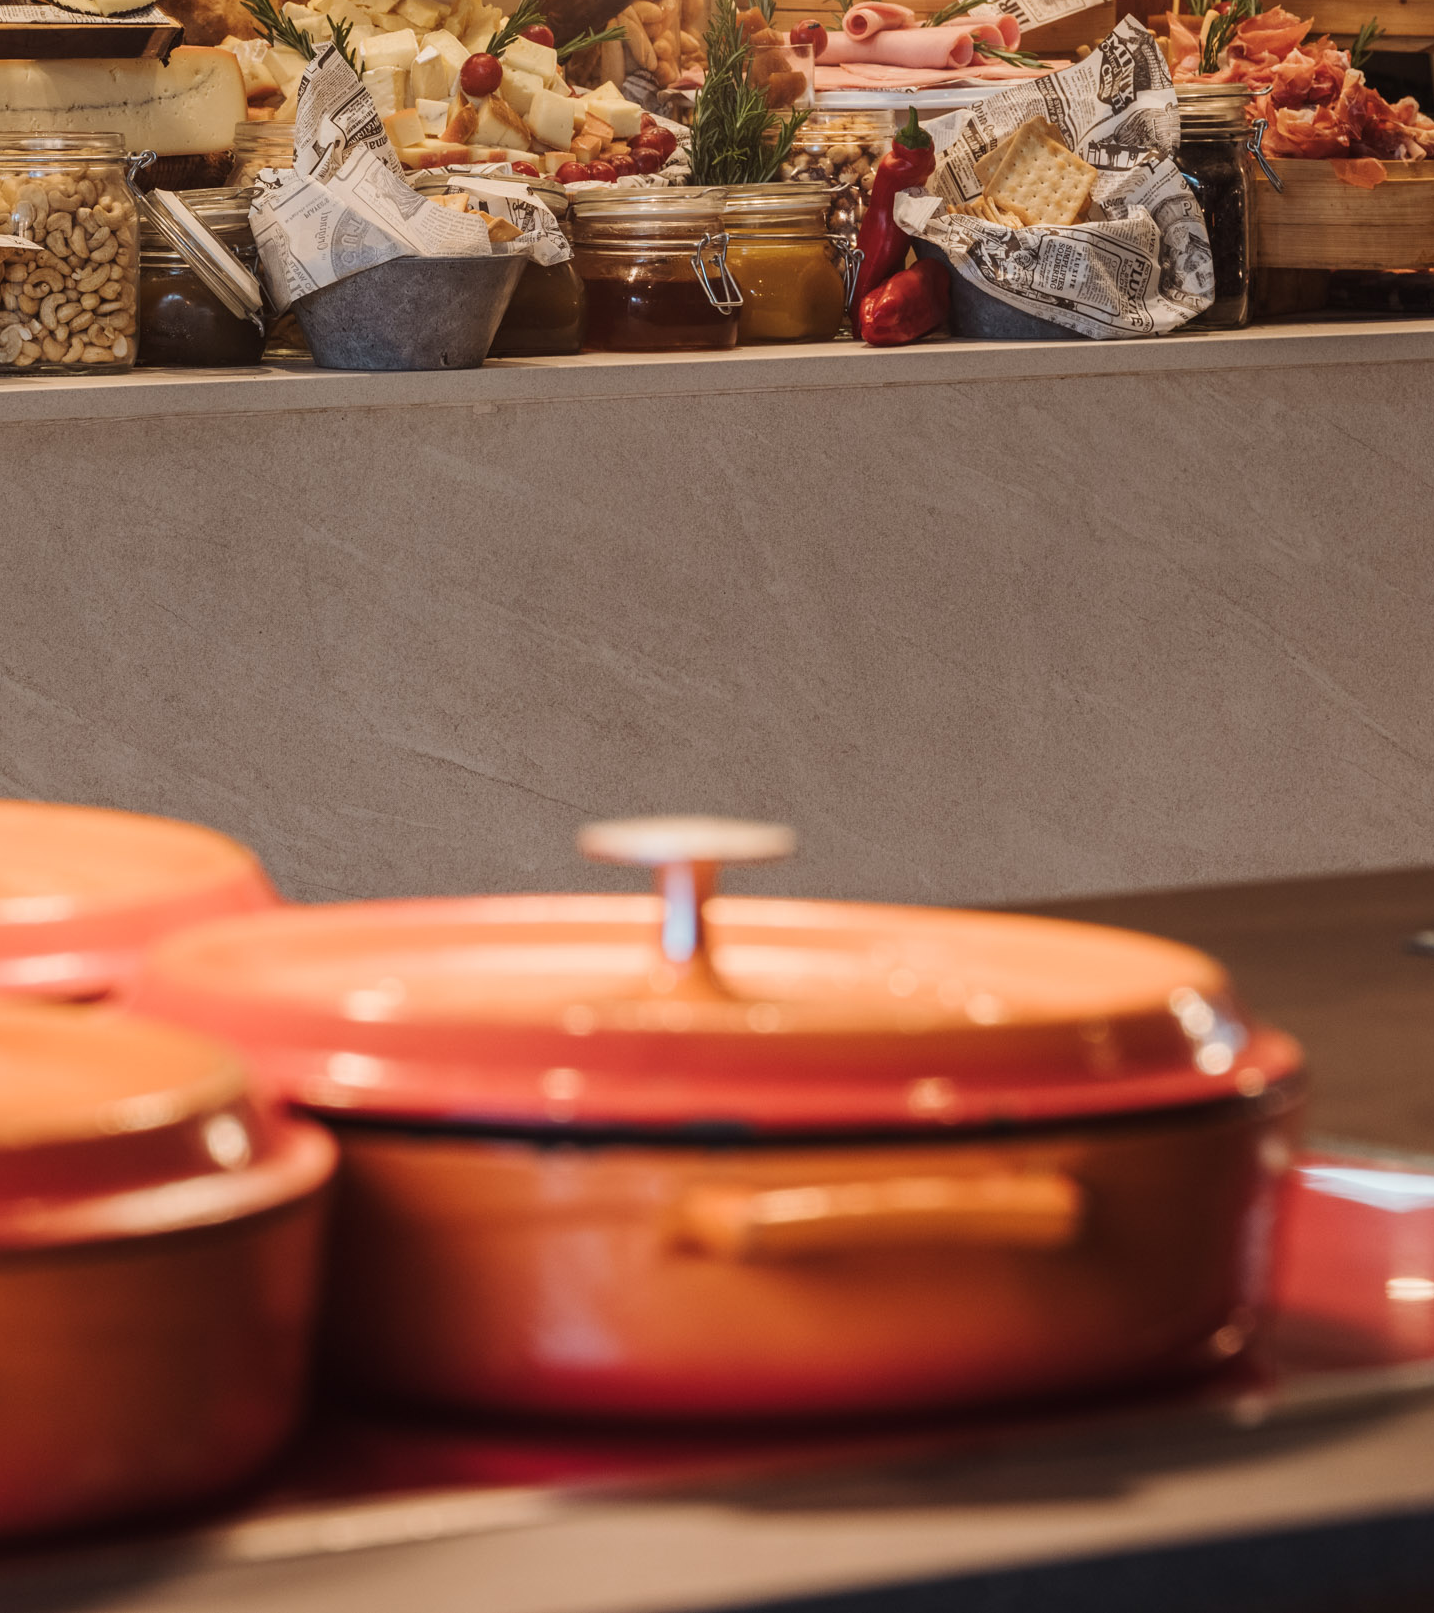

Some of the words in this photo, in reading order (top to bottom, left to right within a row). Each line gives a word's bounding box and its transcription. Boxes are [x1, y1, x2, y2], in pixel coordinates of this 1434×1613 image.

[1101, 42, 1120, 74] Oxford
[1106, 35, 1134, 101] MINTY
[1049, 243, 1065, 289] SOLDERING
[1057, 245, 1072, 290] SIMPLIFIES
[1069, 252, 1082, 288] FLUXITE
[1127, 258, 1145, 326] FLUXITE
